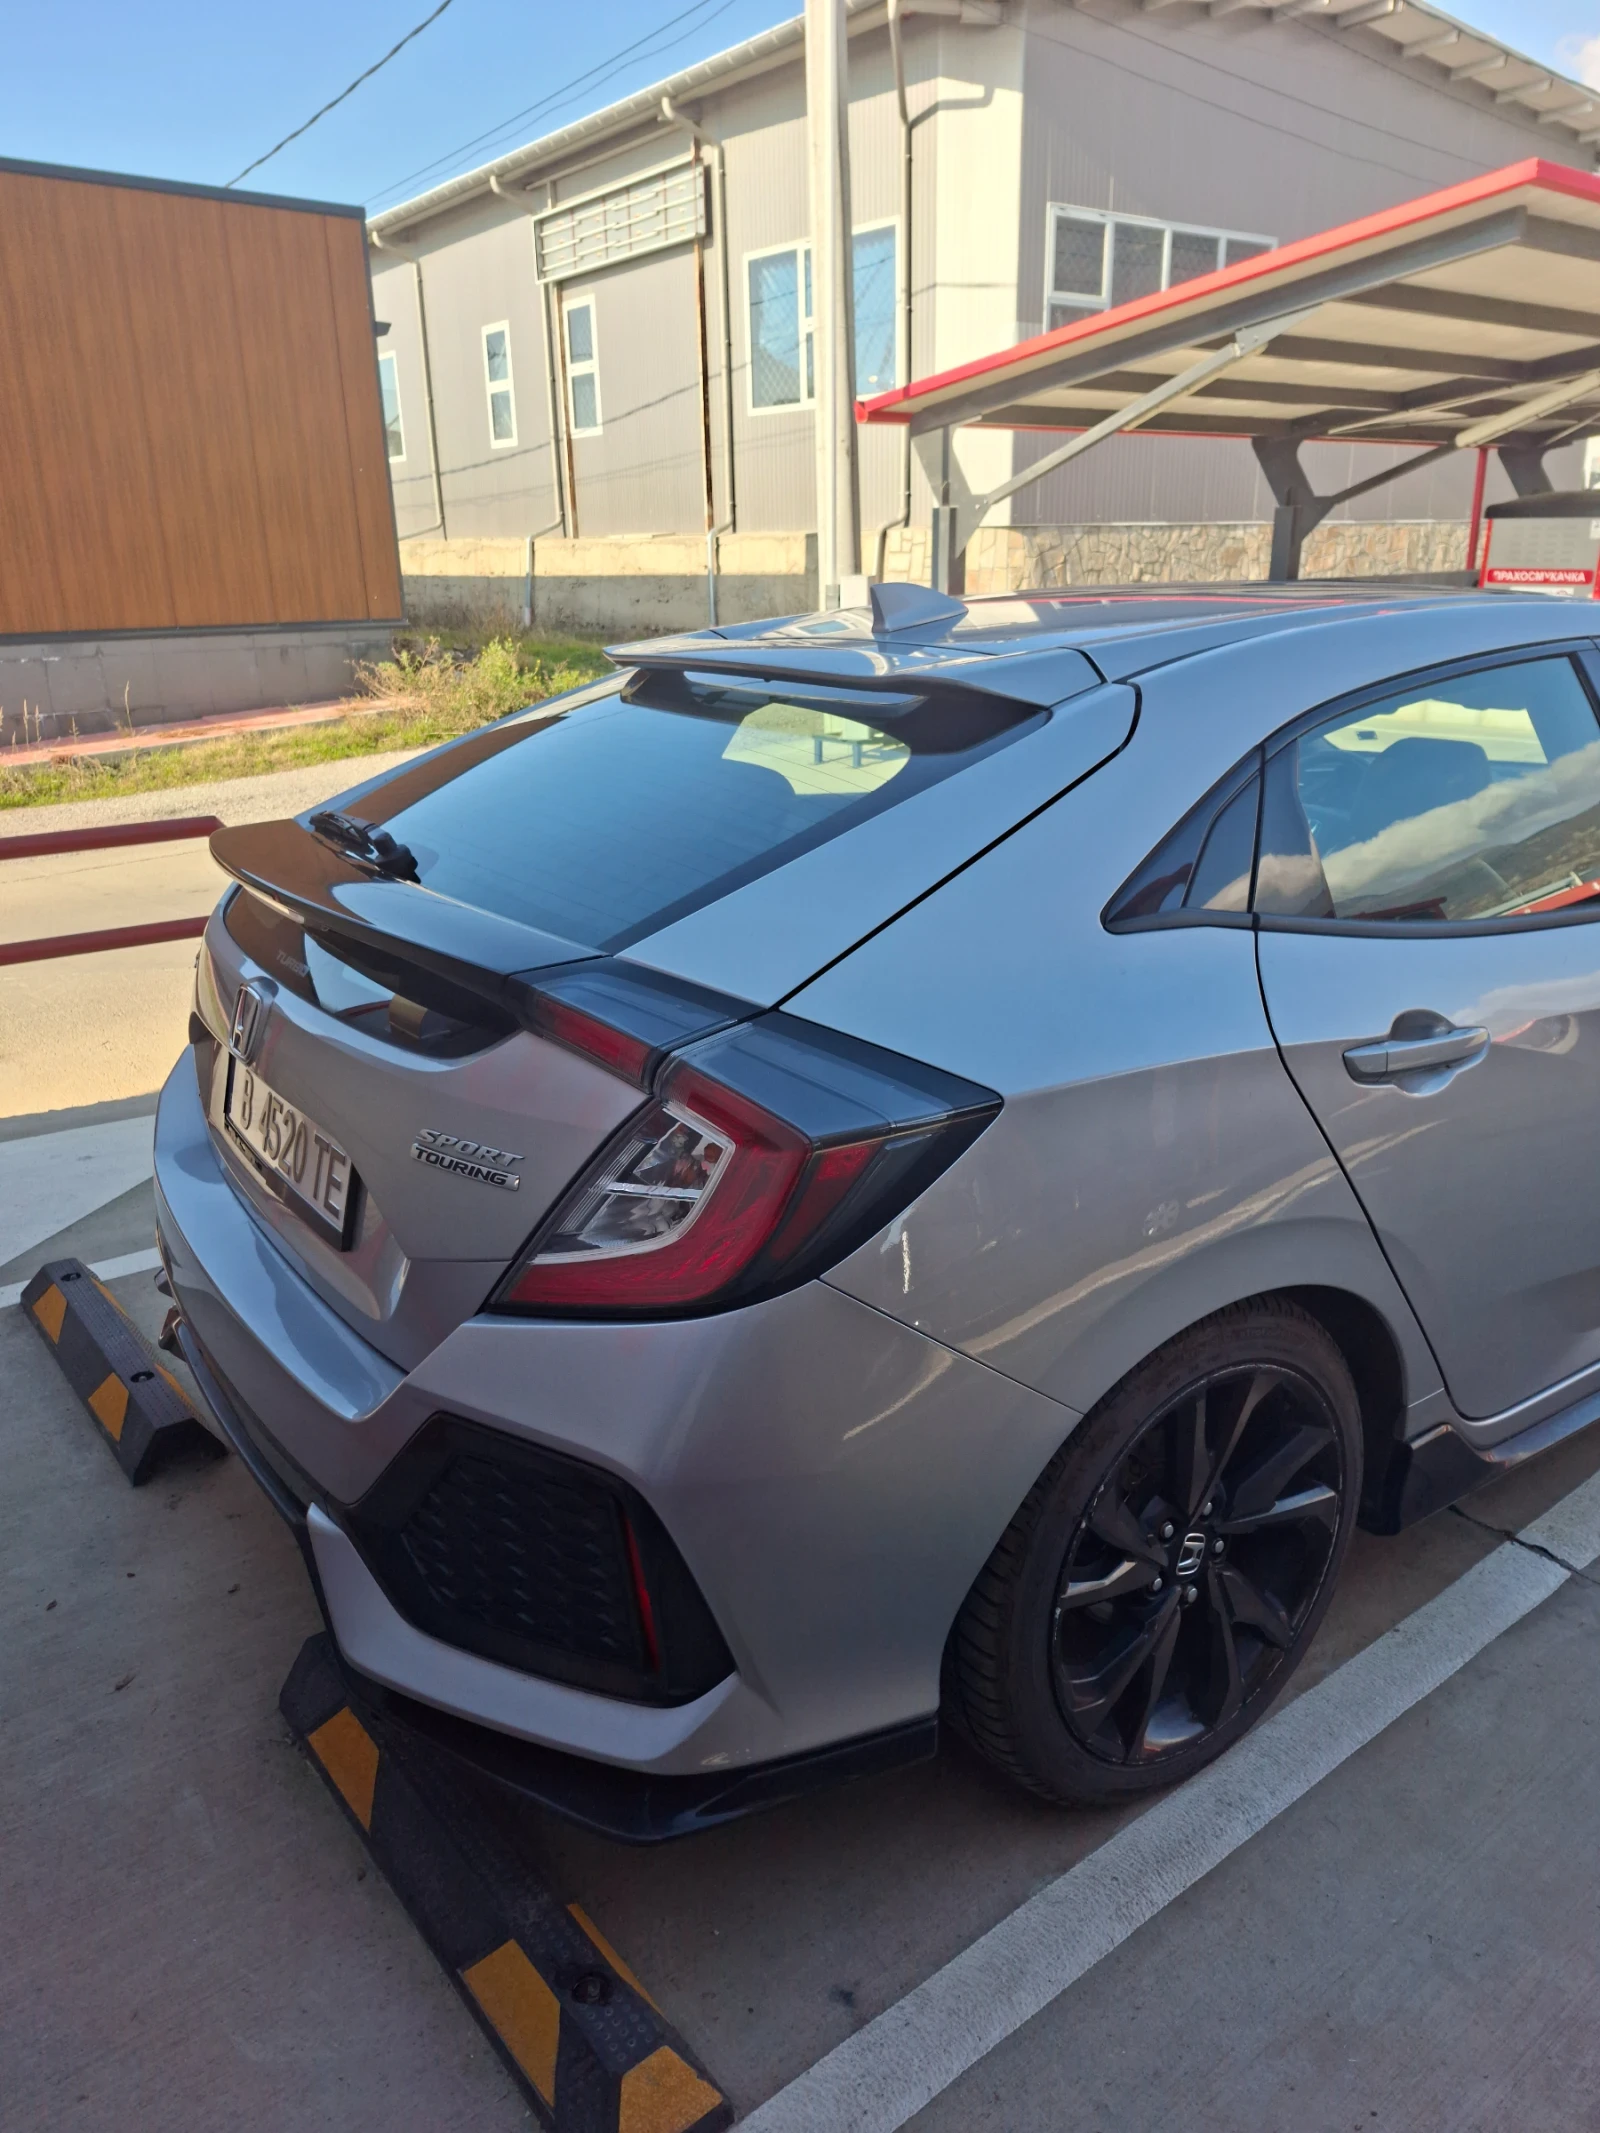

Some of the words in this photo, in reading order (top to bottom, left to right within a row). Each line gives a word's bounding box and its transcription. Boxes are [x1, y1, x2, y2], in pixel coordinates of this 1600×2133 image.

[276, 949, 310, 977] TURBO
[240, 1069, 255, 1130] B
[258, 1091, 308, 1184] 4520
[312, 1131, 347, 1220] TE
[415, 1128, 525, 1167] SPORT
[415, 1146, 509, 1186] TOURING
